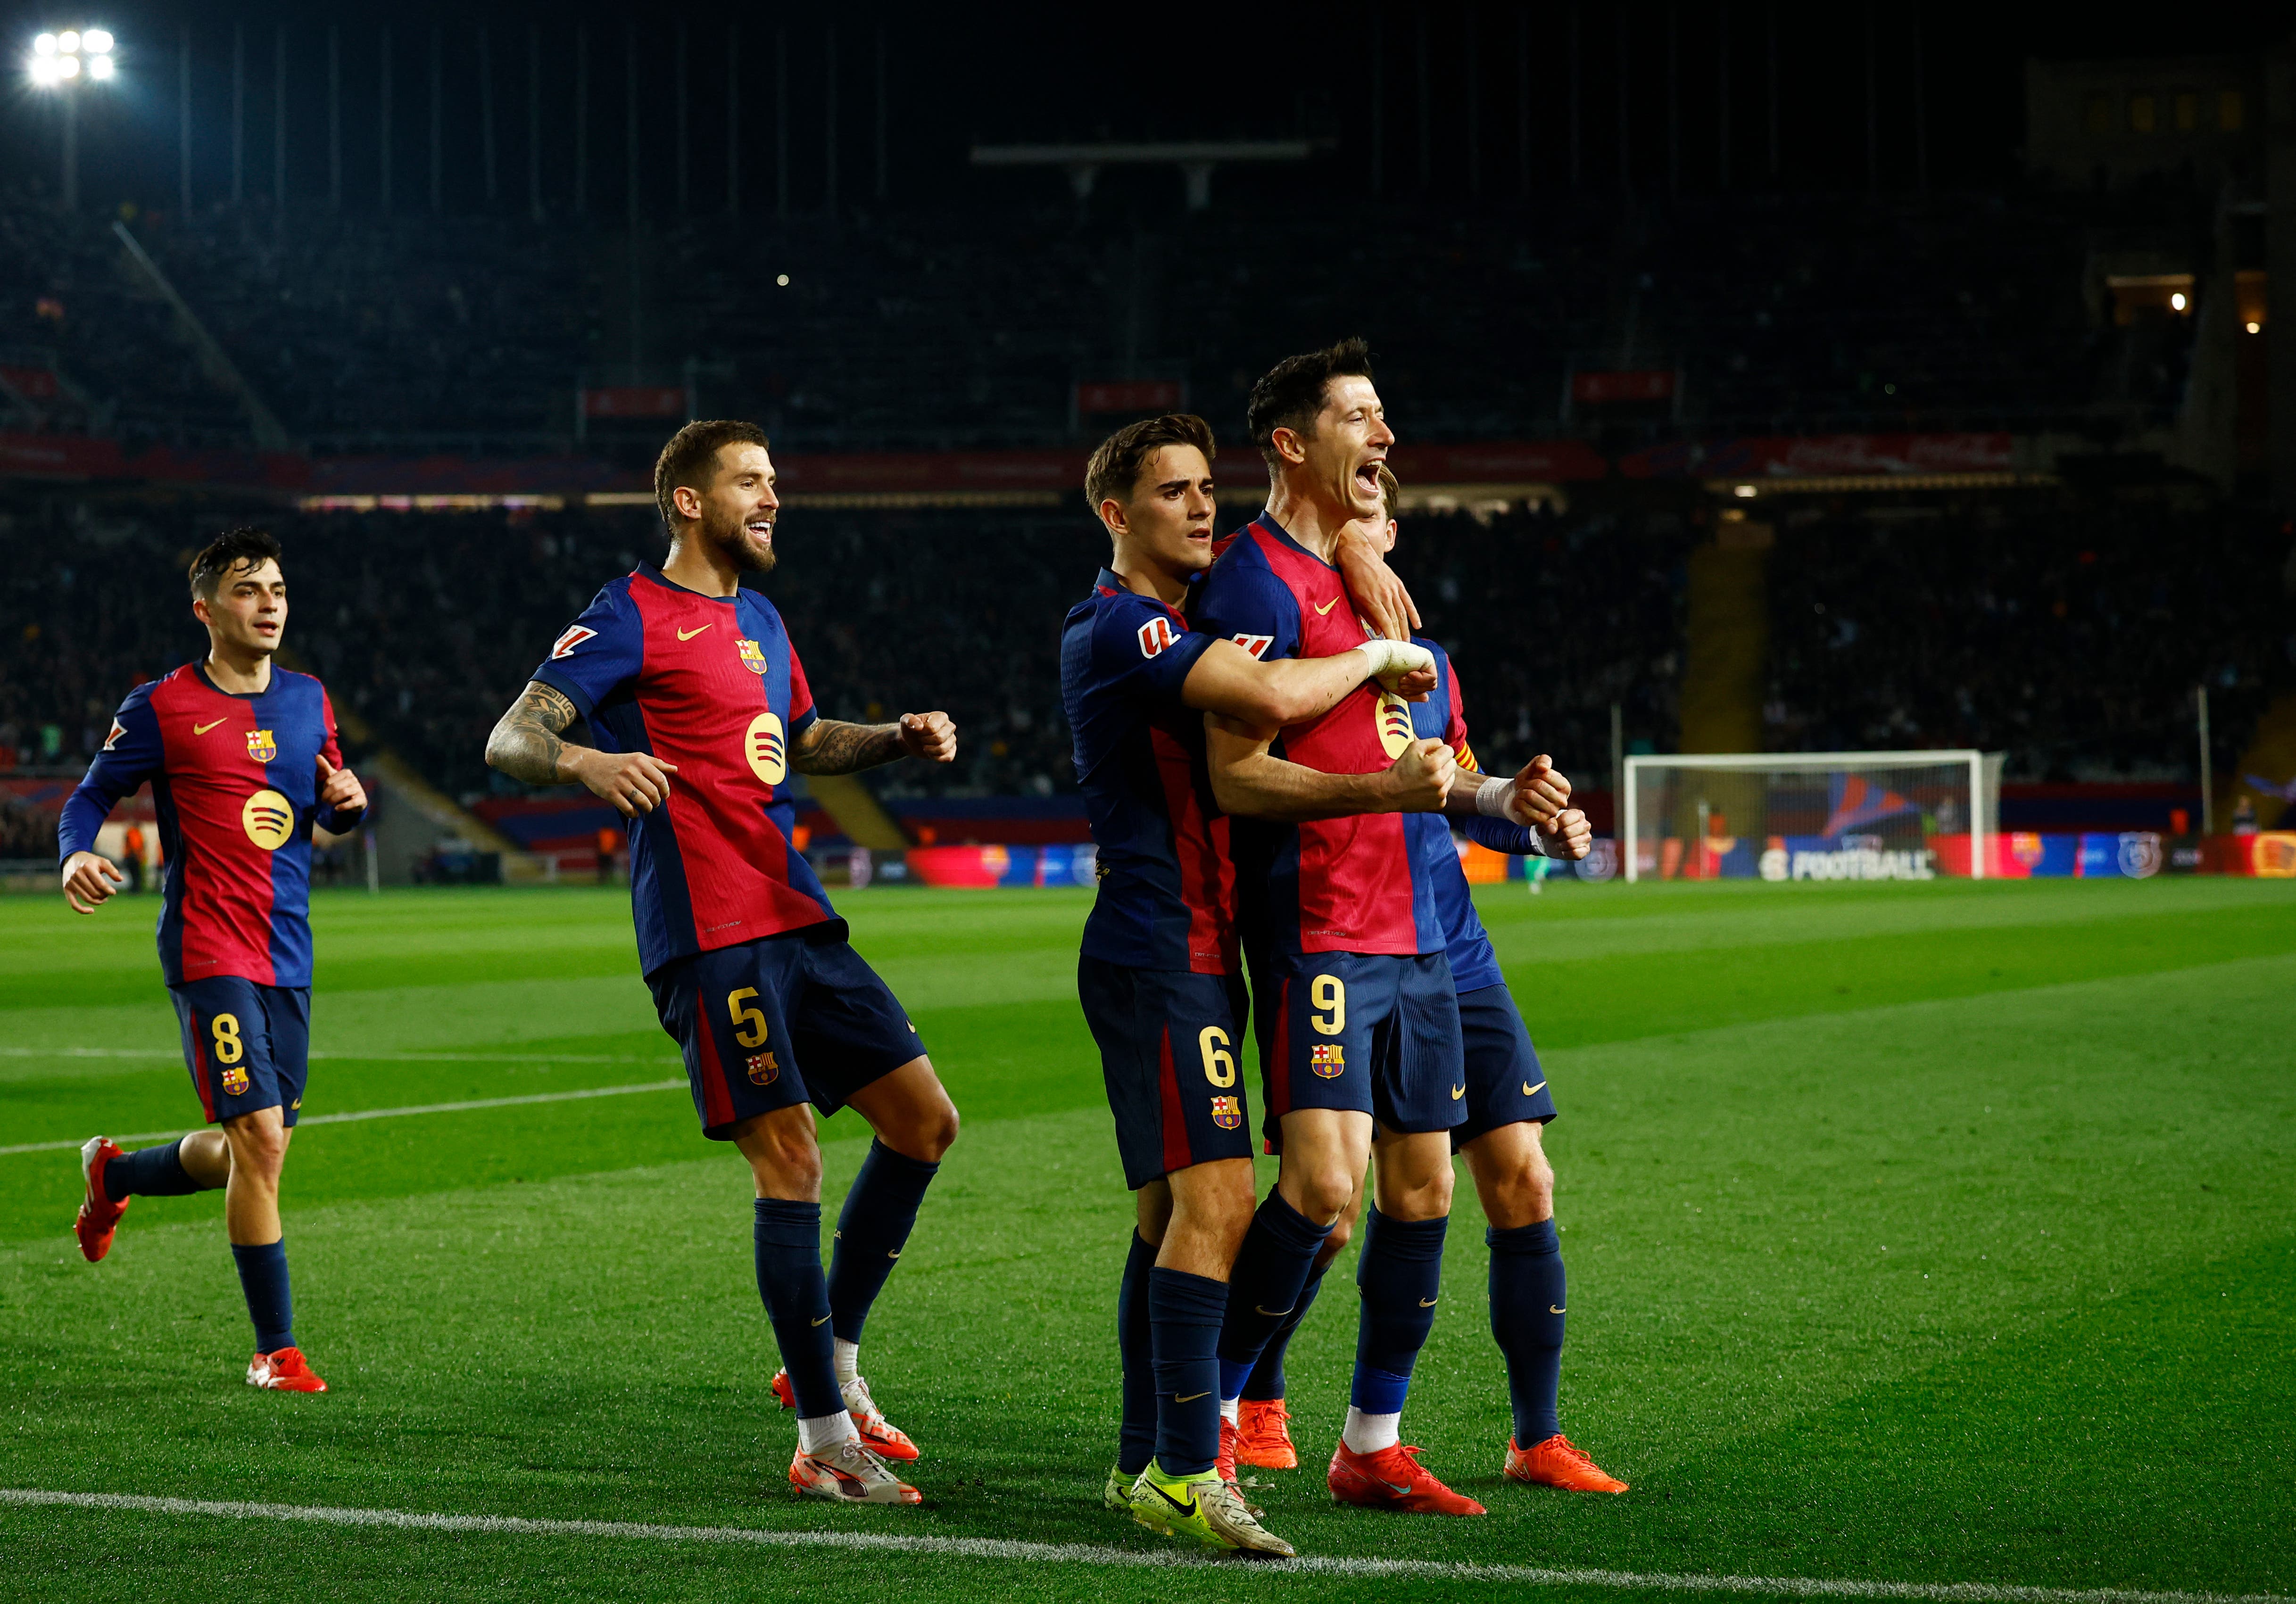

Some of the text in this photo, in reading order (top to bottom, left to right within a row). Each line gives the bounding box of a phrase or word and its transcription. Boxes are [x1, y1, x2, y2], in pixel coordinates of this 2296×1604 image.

[728, 986, 768, 1048] 5
[1311, 974, 1345, 1035] 9
[212, 1013, 243, 1064] 8
[1199, 1025, 1235, 1088] 6
